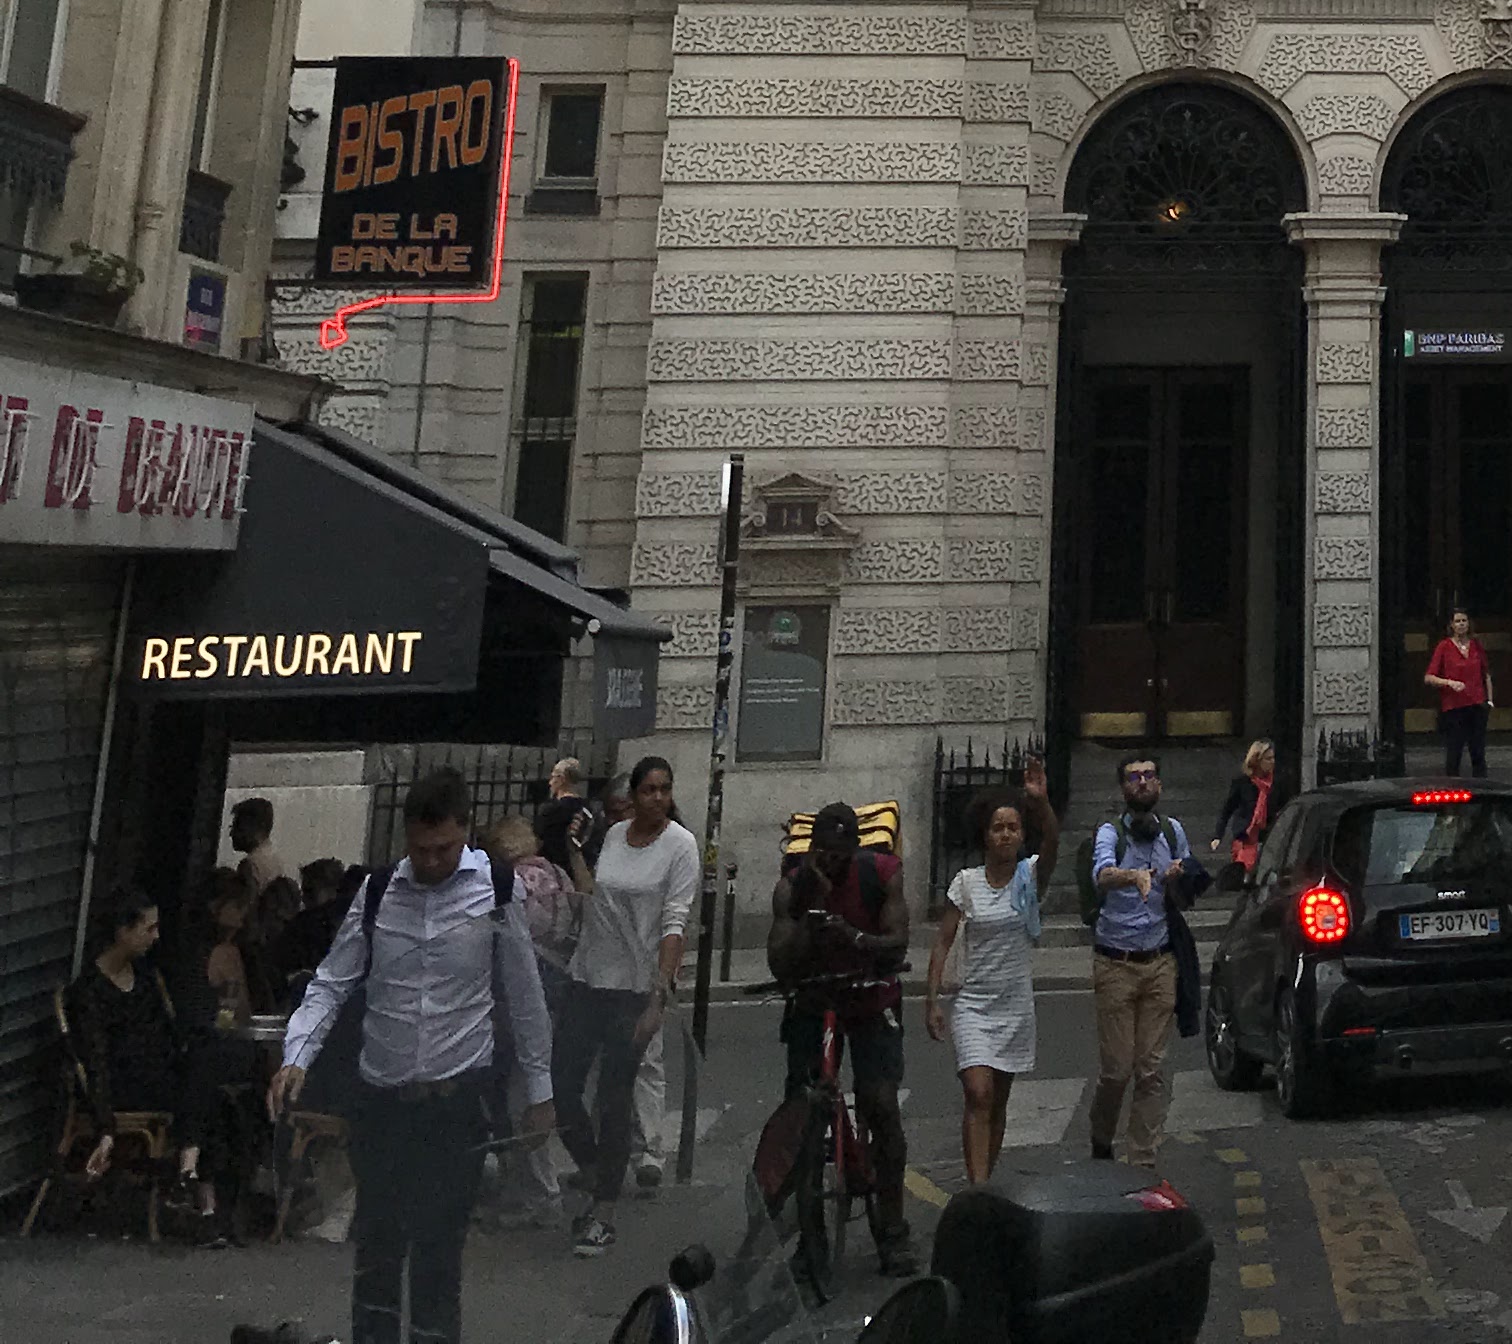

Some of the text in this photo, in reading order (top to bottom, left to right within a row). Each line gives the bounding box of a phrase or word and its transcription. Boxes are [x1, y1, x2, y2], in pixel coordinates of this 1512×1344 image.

[334, 79, 492, 192] BISTRO
[352, 213, 458, 239] DE LA
[331, 246, 472, 277] BANQUE
[142, 632, 421, 679] RESTAURANT
